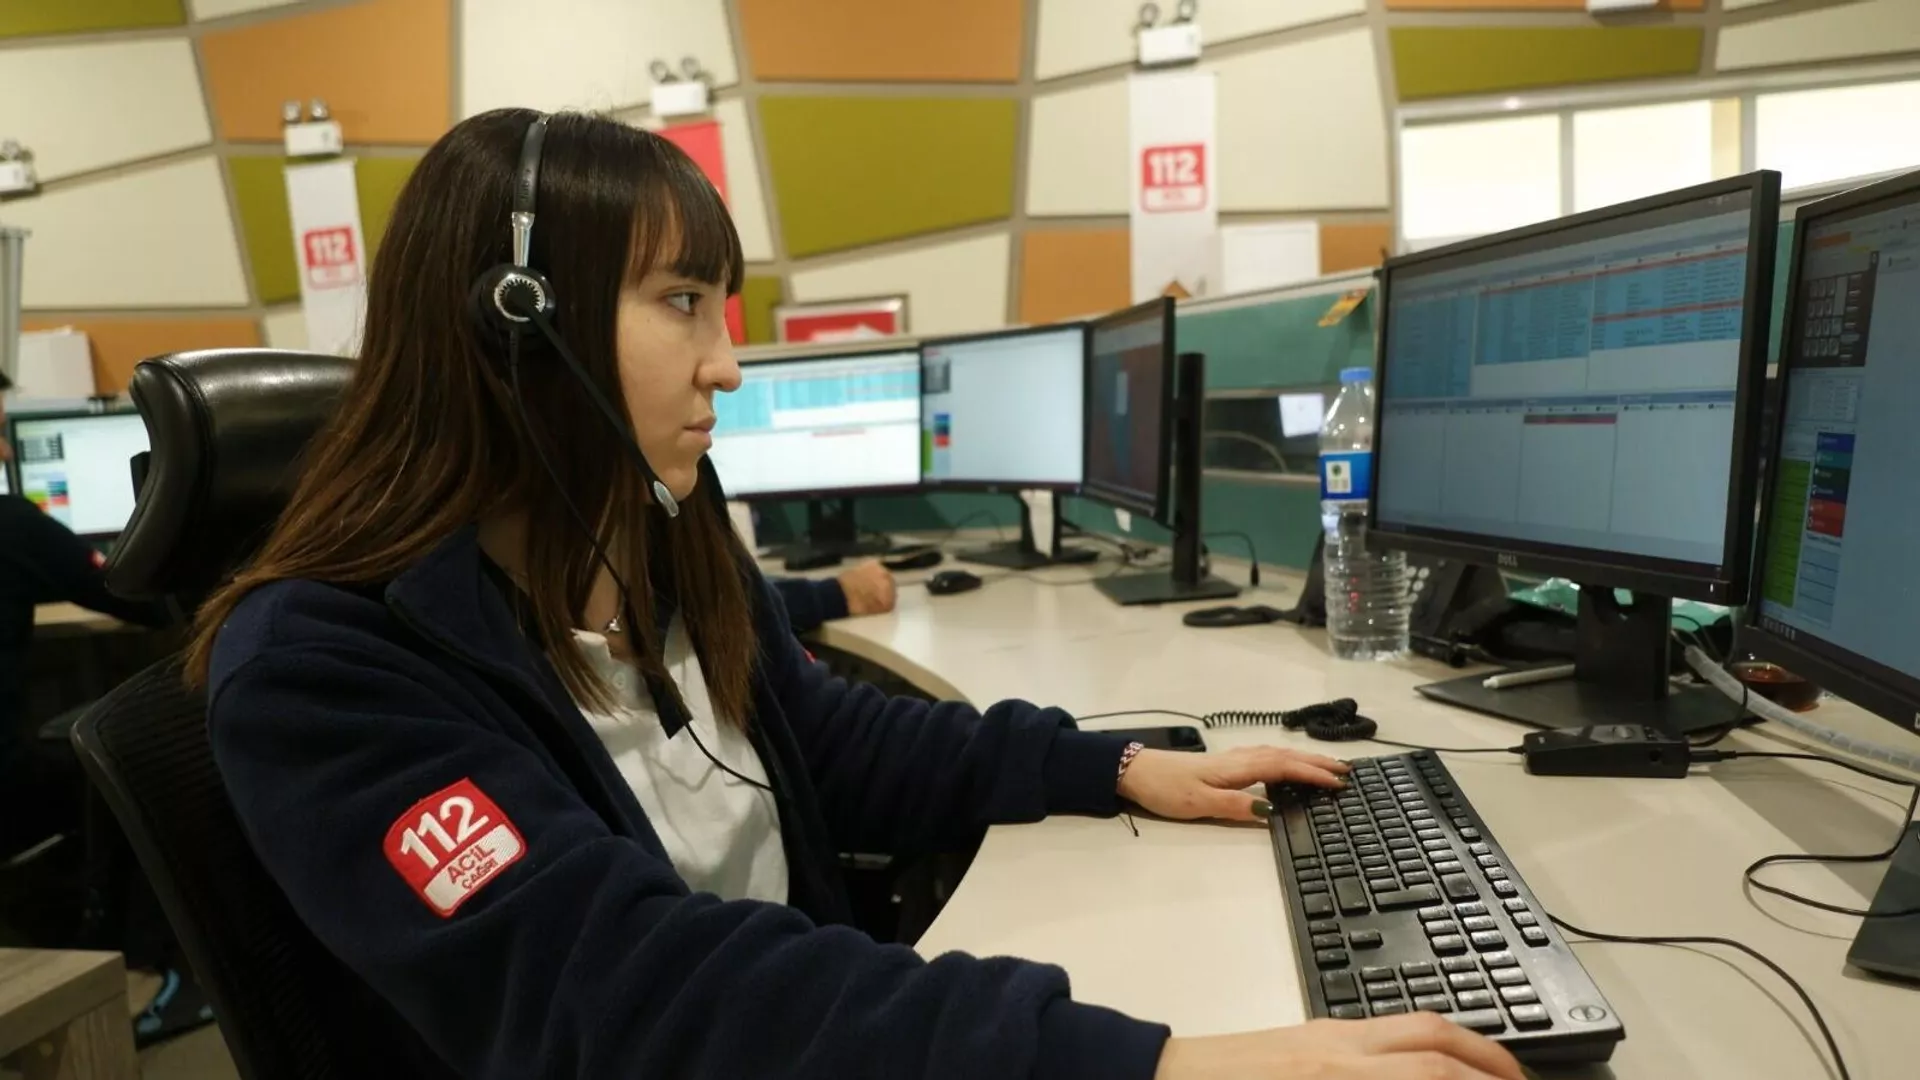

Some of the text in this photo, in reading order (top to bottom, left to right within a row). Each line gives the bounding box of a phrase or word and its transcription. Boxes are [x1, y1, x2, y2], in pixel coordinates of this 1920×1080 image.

[1150, 148, 1198, 184] 112
[310, 231, 348, 263] 112
[400, 796, 490, 870] 112
